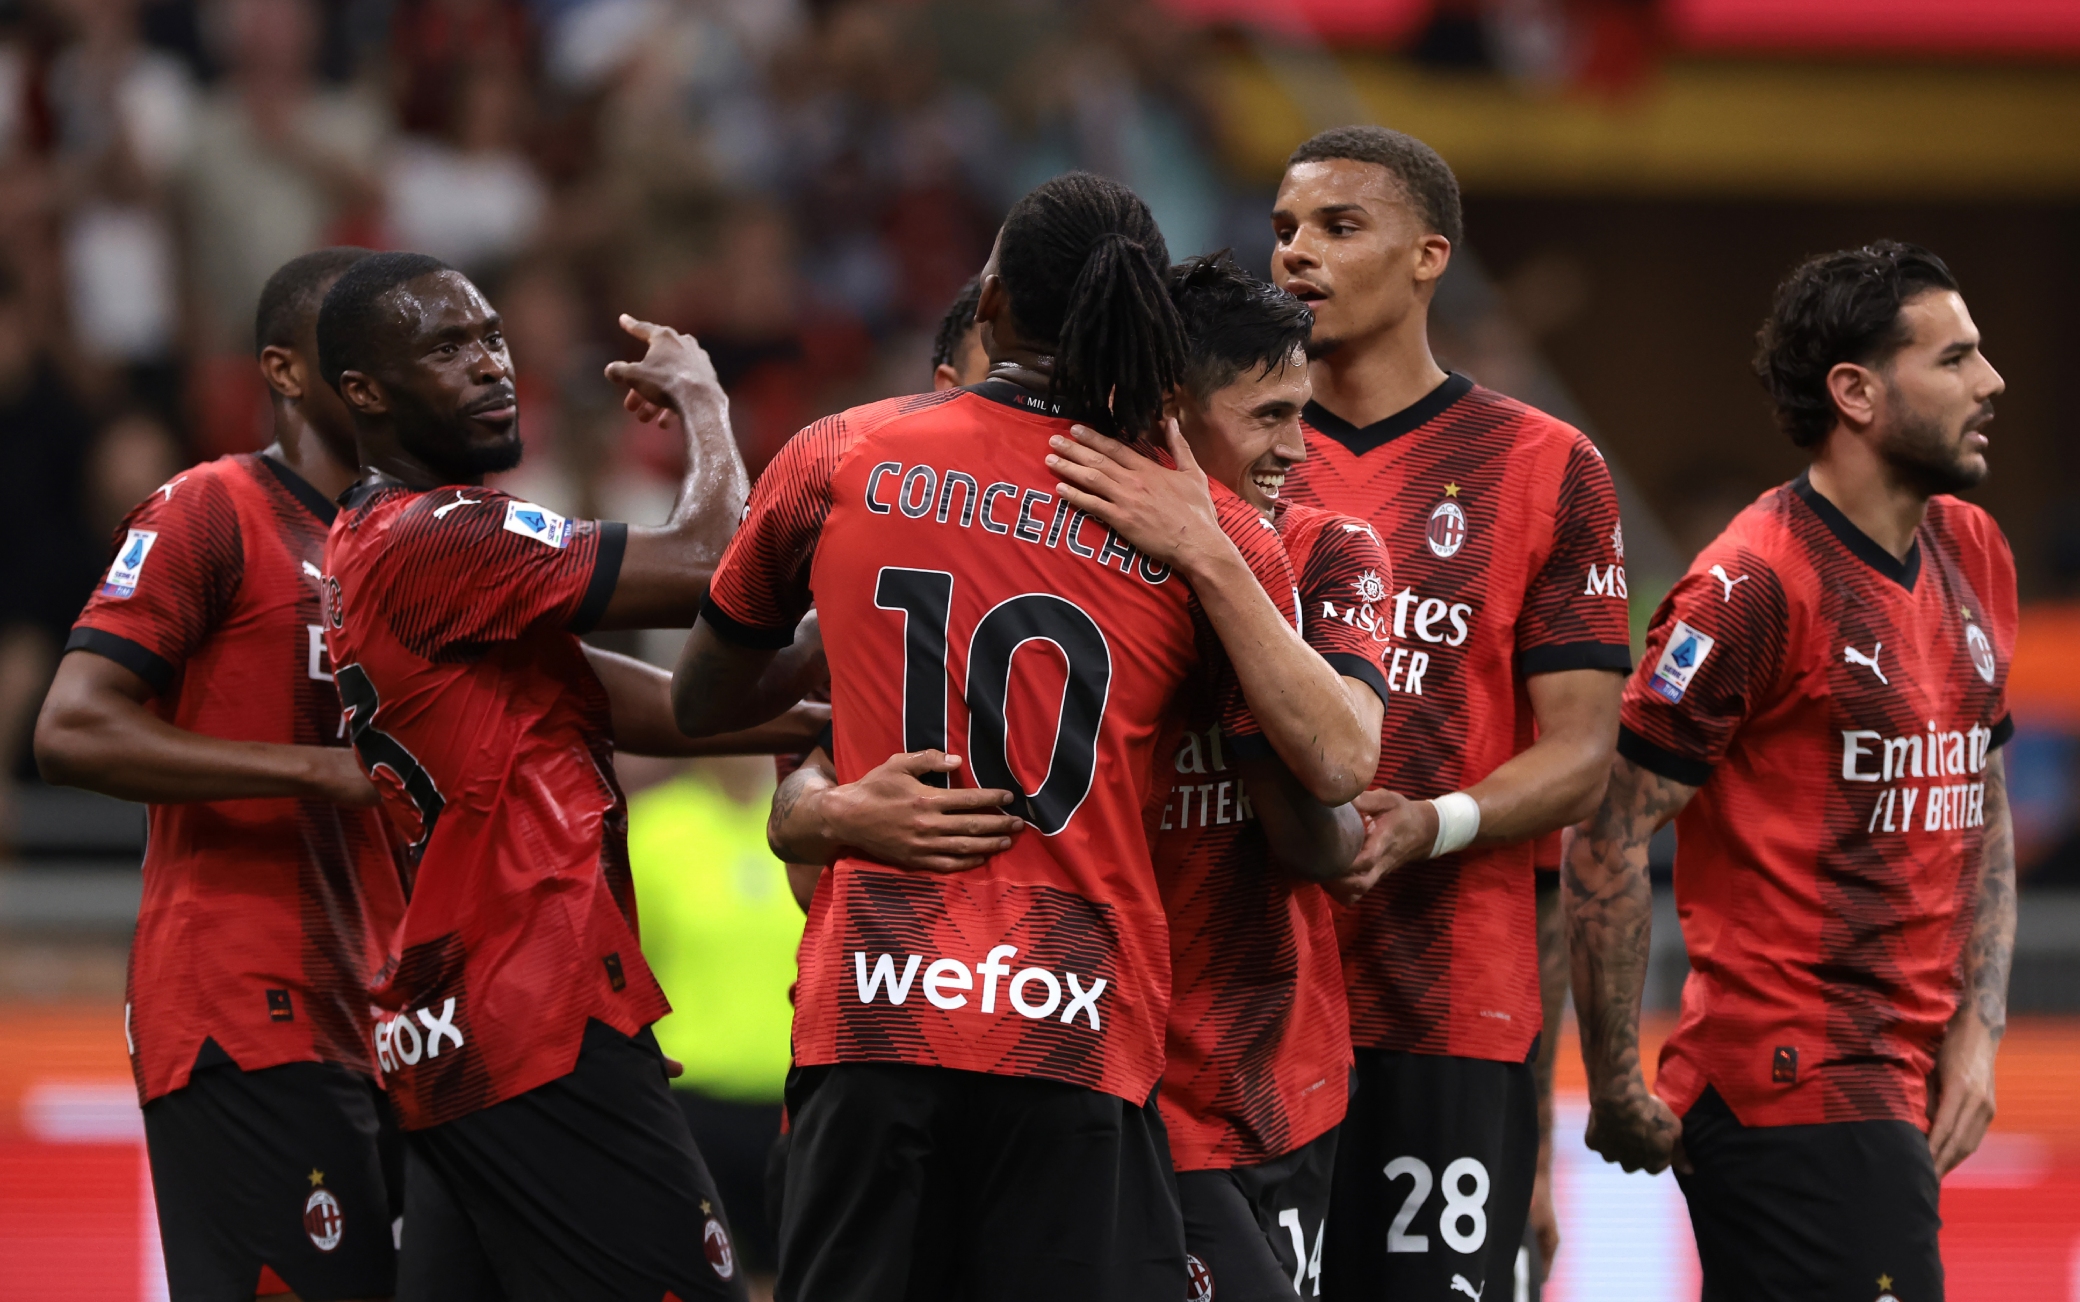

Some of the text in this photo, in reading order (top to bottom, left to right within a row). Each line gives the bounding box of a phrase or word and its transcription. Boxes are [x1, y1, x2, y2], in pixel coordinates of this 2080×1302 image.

[1027, 396, 1060, 414] MILN
[1434, 545, 1454, 553] 1899
[874, 565, 1113, 837] 10
[1868, 781, 1985, 834] FLY BETTER
[854, 944, 1108, 1032] wefox
[1383, 1156, 1490, 1254] 28
[1278, 1207, 1325, 1298] 14
